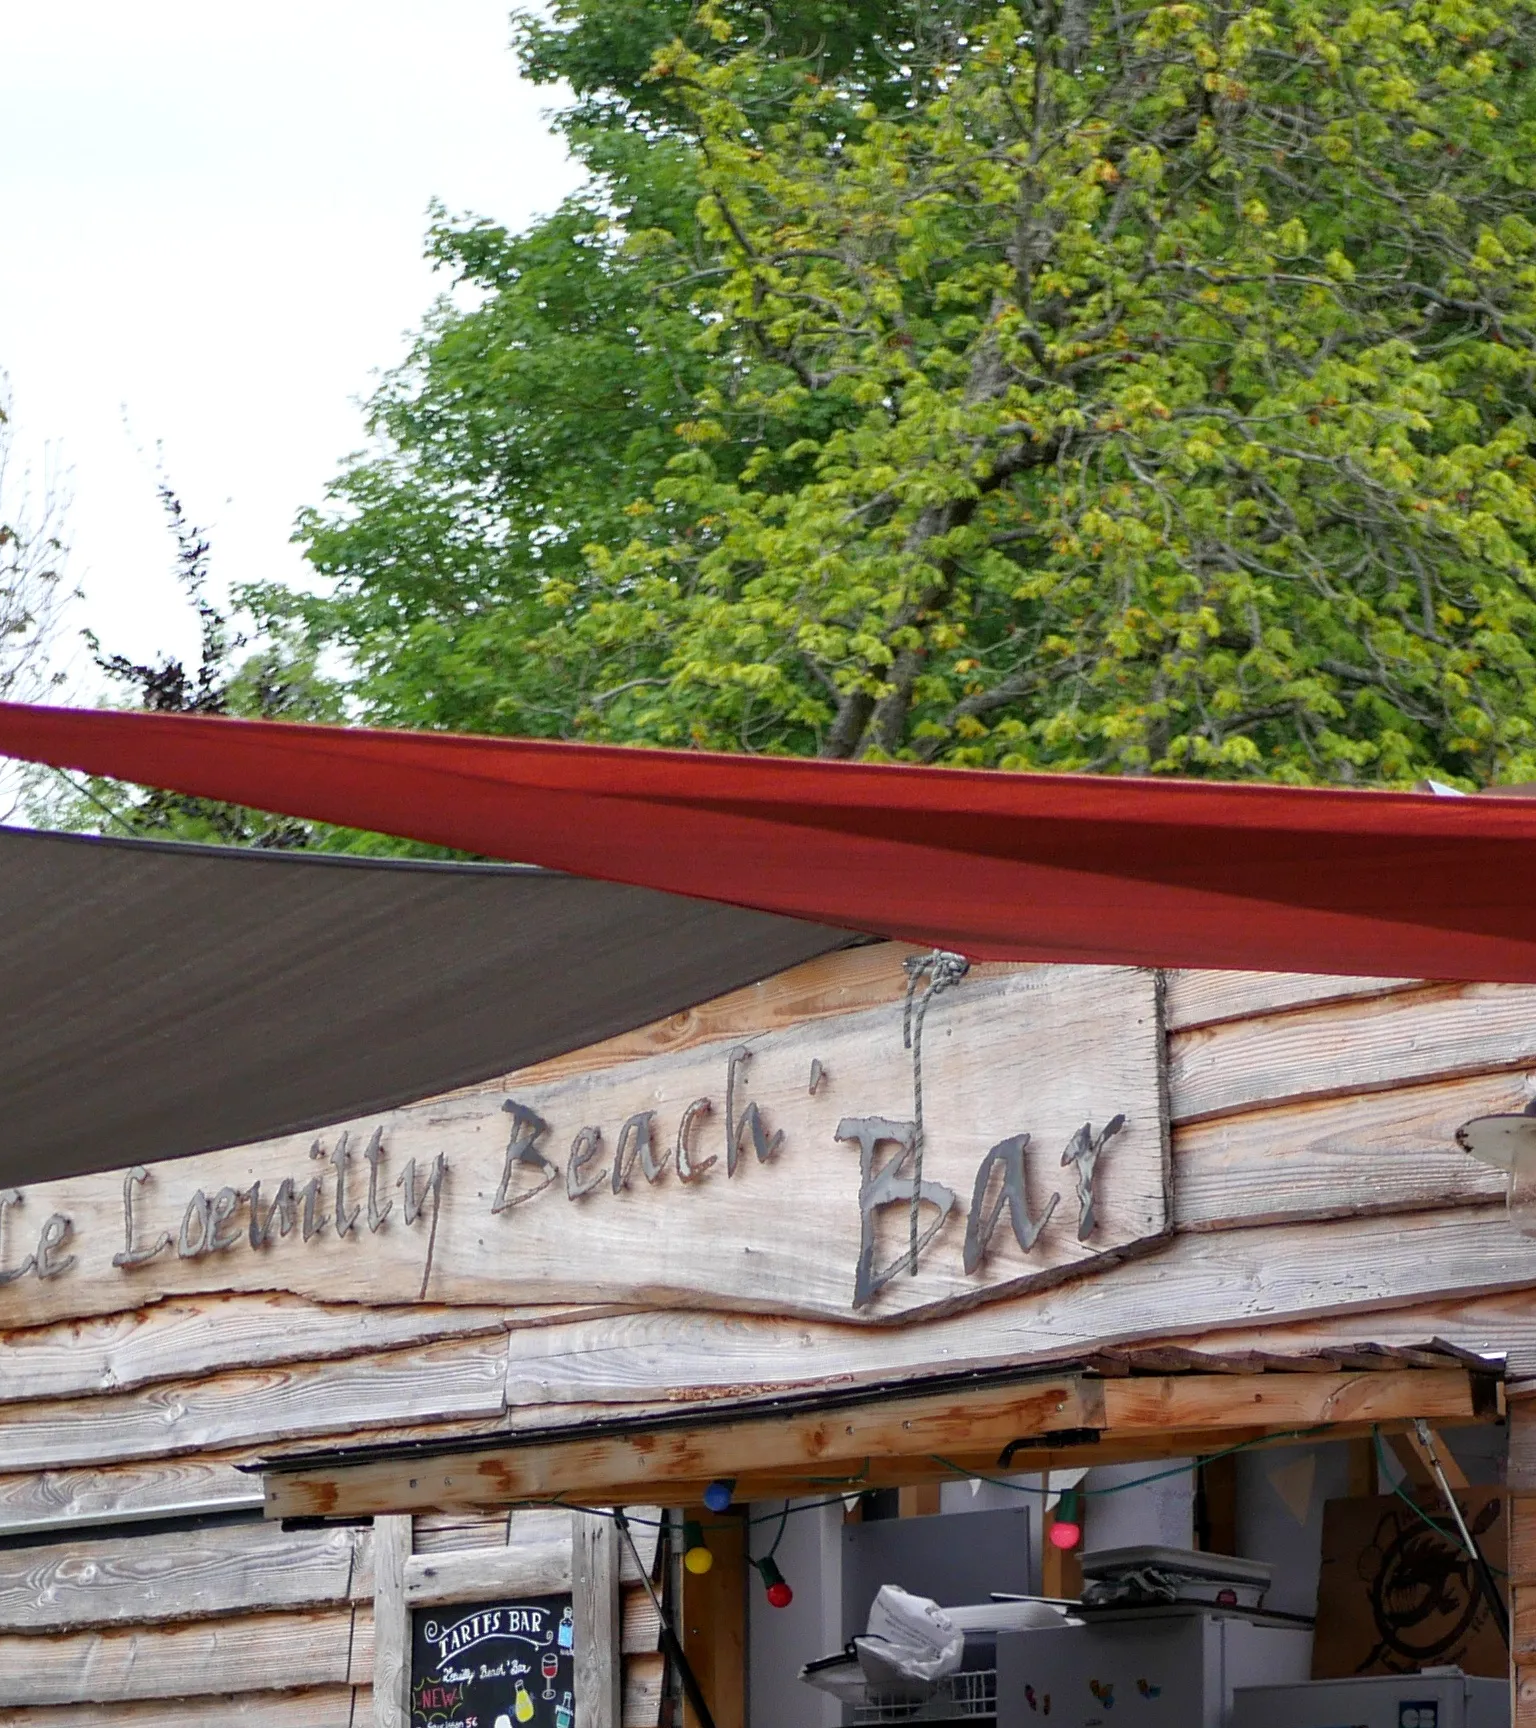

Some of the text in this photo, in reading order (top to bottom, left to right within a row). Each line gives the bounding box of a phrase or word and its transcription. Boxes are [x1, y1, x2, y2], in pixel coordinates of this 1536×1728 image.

[834, 1113, 1126, 1310] Bar
[438, 1611, 541, 1658] TARIFS BAR
[421, 1686, 457, 1709] NEW
